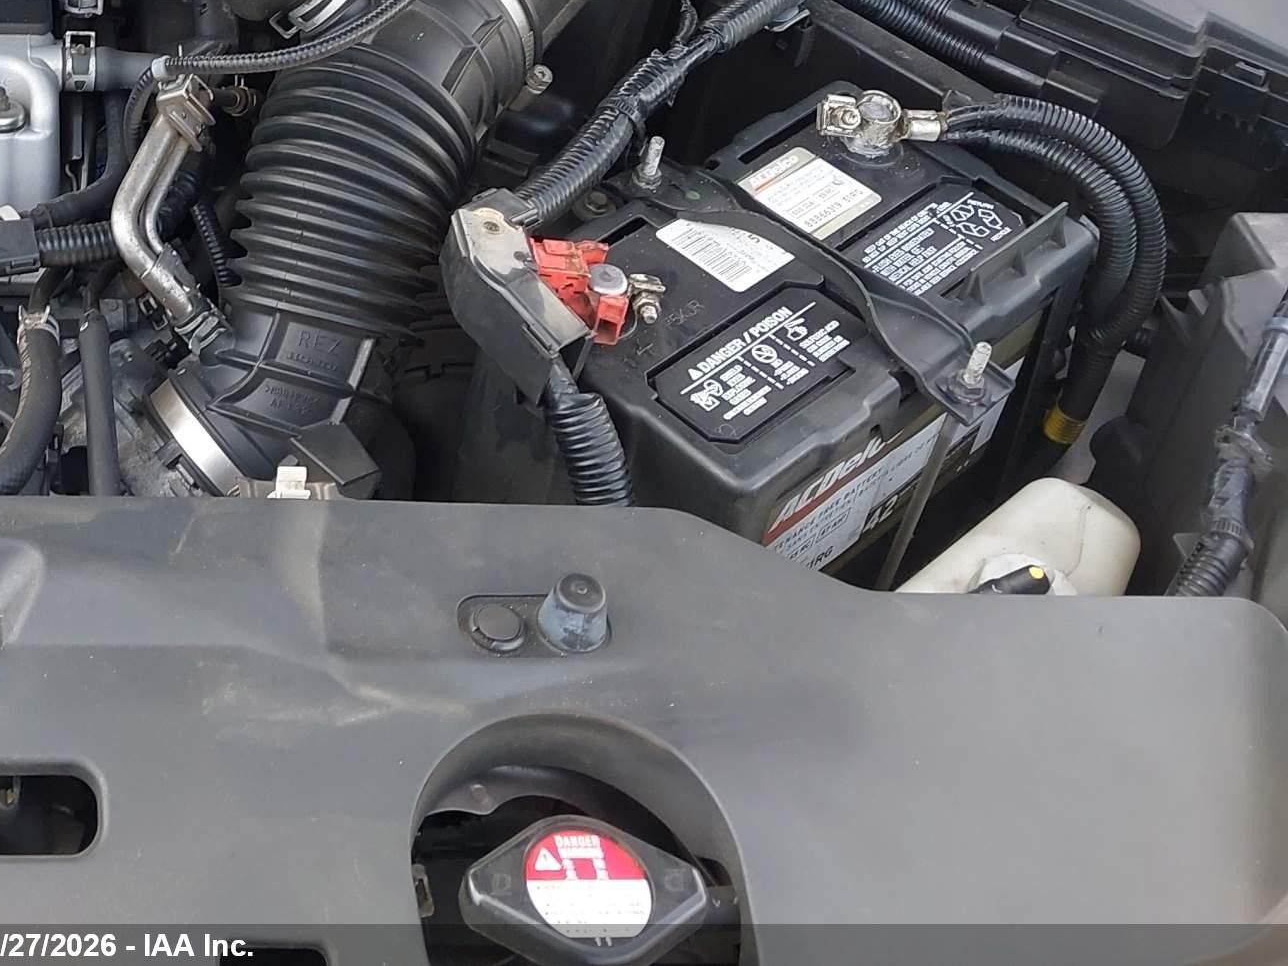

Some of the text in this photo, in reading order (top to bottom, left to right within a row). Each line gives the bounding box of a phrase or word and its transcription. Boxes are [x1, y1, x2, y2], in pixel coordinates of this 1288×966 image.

[696, 338, 747, 374] DANGER
[749, 306, 793, 337] POISON
[767, 429, 904, 534] ACDelc
[805, 545, 834, 570] 1RG
